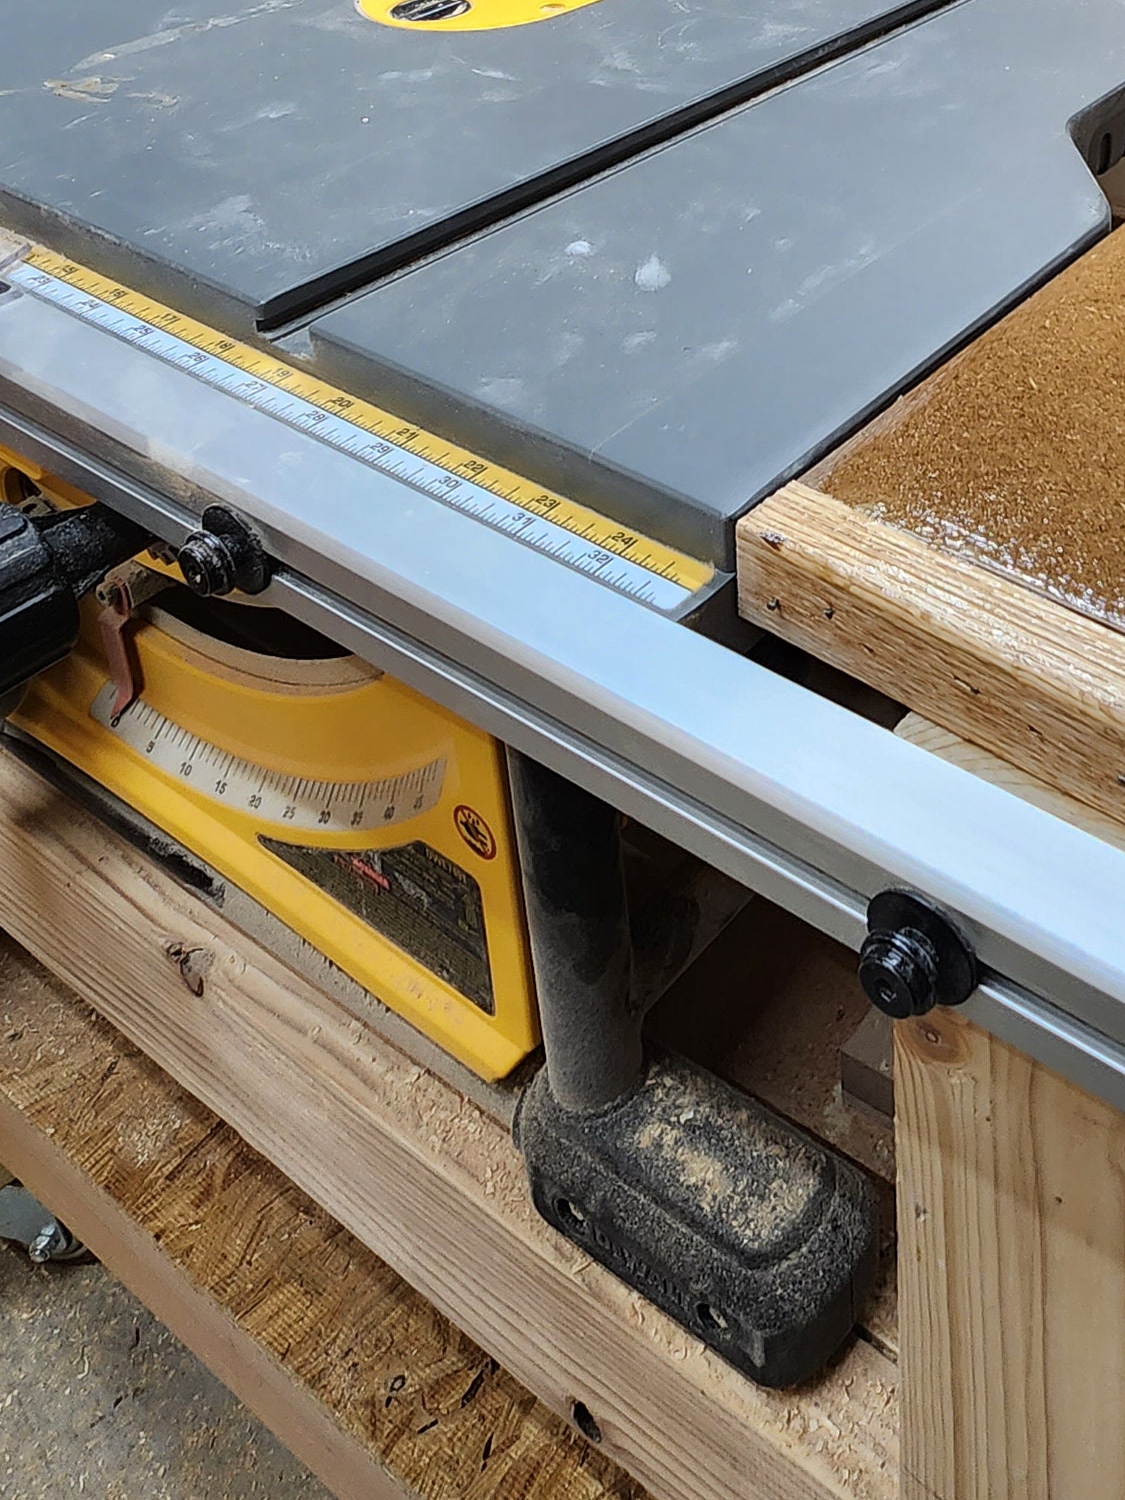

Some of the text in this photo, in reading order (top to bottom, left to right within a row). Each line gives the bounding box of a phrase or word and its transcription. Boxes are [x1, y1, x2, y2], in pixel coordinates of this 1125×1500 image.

[135, 323, 150, 337] 25
[187, 351, 204, 364] 26
[244, 379, 262, 392] 27
[306, 409, 324, 425] 28
[370, 440, 390, 457] 29
[439, 474, 459, 491] 30
[512, 511, 531, 527] 31
[587, 548, 609, 565] 32
[215, 338, 230, 351] 18
[273, 367, 291, 380] 19
[333, 394, 351, 409] 20
[397, 427, 415, 441] 21
[464, 460, 483, 473] 22
[536, 494, 556, 510] 23
[611, 531, 632, 548] 24
[146, 741, 155, 754] 5
[179, 761, 193, 777] 10
[213, 779, 227, 796] 15
[248, 794, 263, 810] 20
[281, 806, 296, 821] 25
[317, 810, 332, 826] 30
